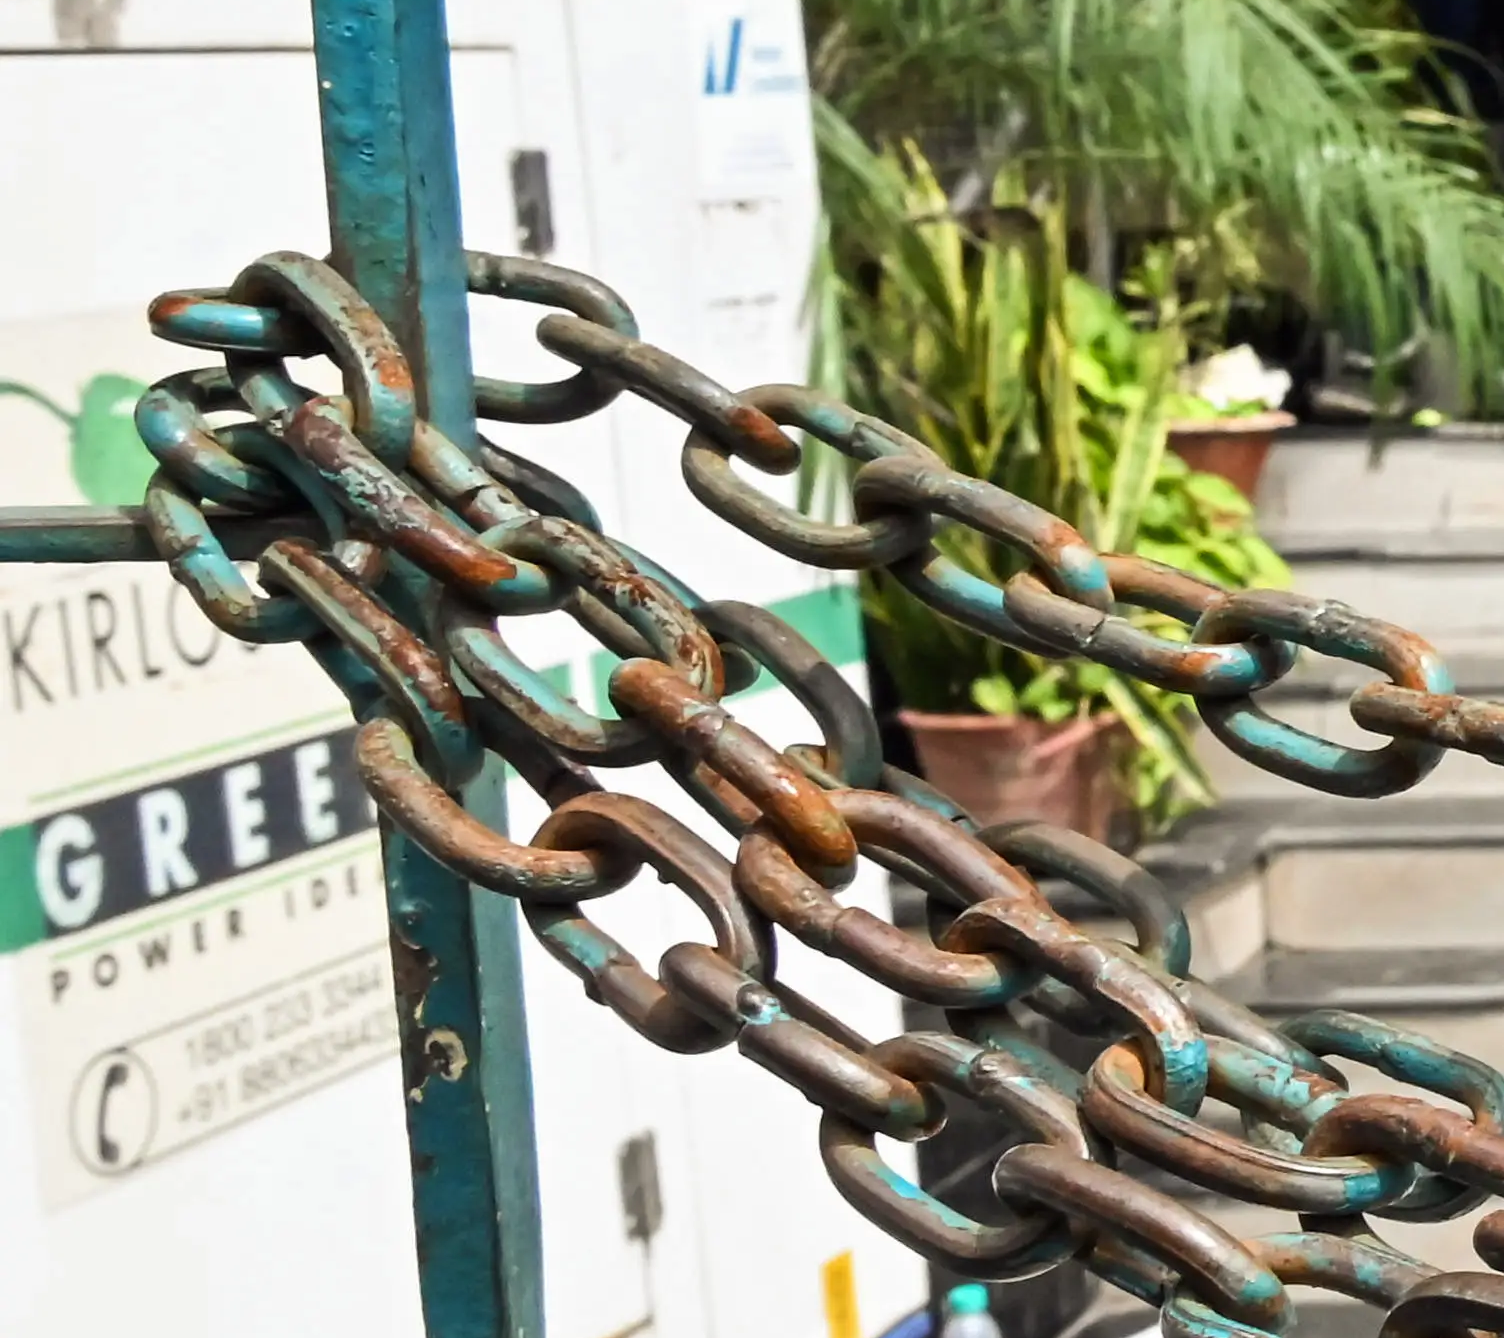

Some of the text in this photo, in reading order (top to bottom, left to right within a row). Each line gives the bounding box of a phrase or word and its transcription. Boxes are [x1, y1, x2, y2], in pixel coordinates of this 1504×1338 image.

[4, 579, 262, 714] KIRLO
[35, 738, 378, 929] GREE
[50, 863, 384, 1005] POWER IDE
